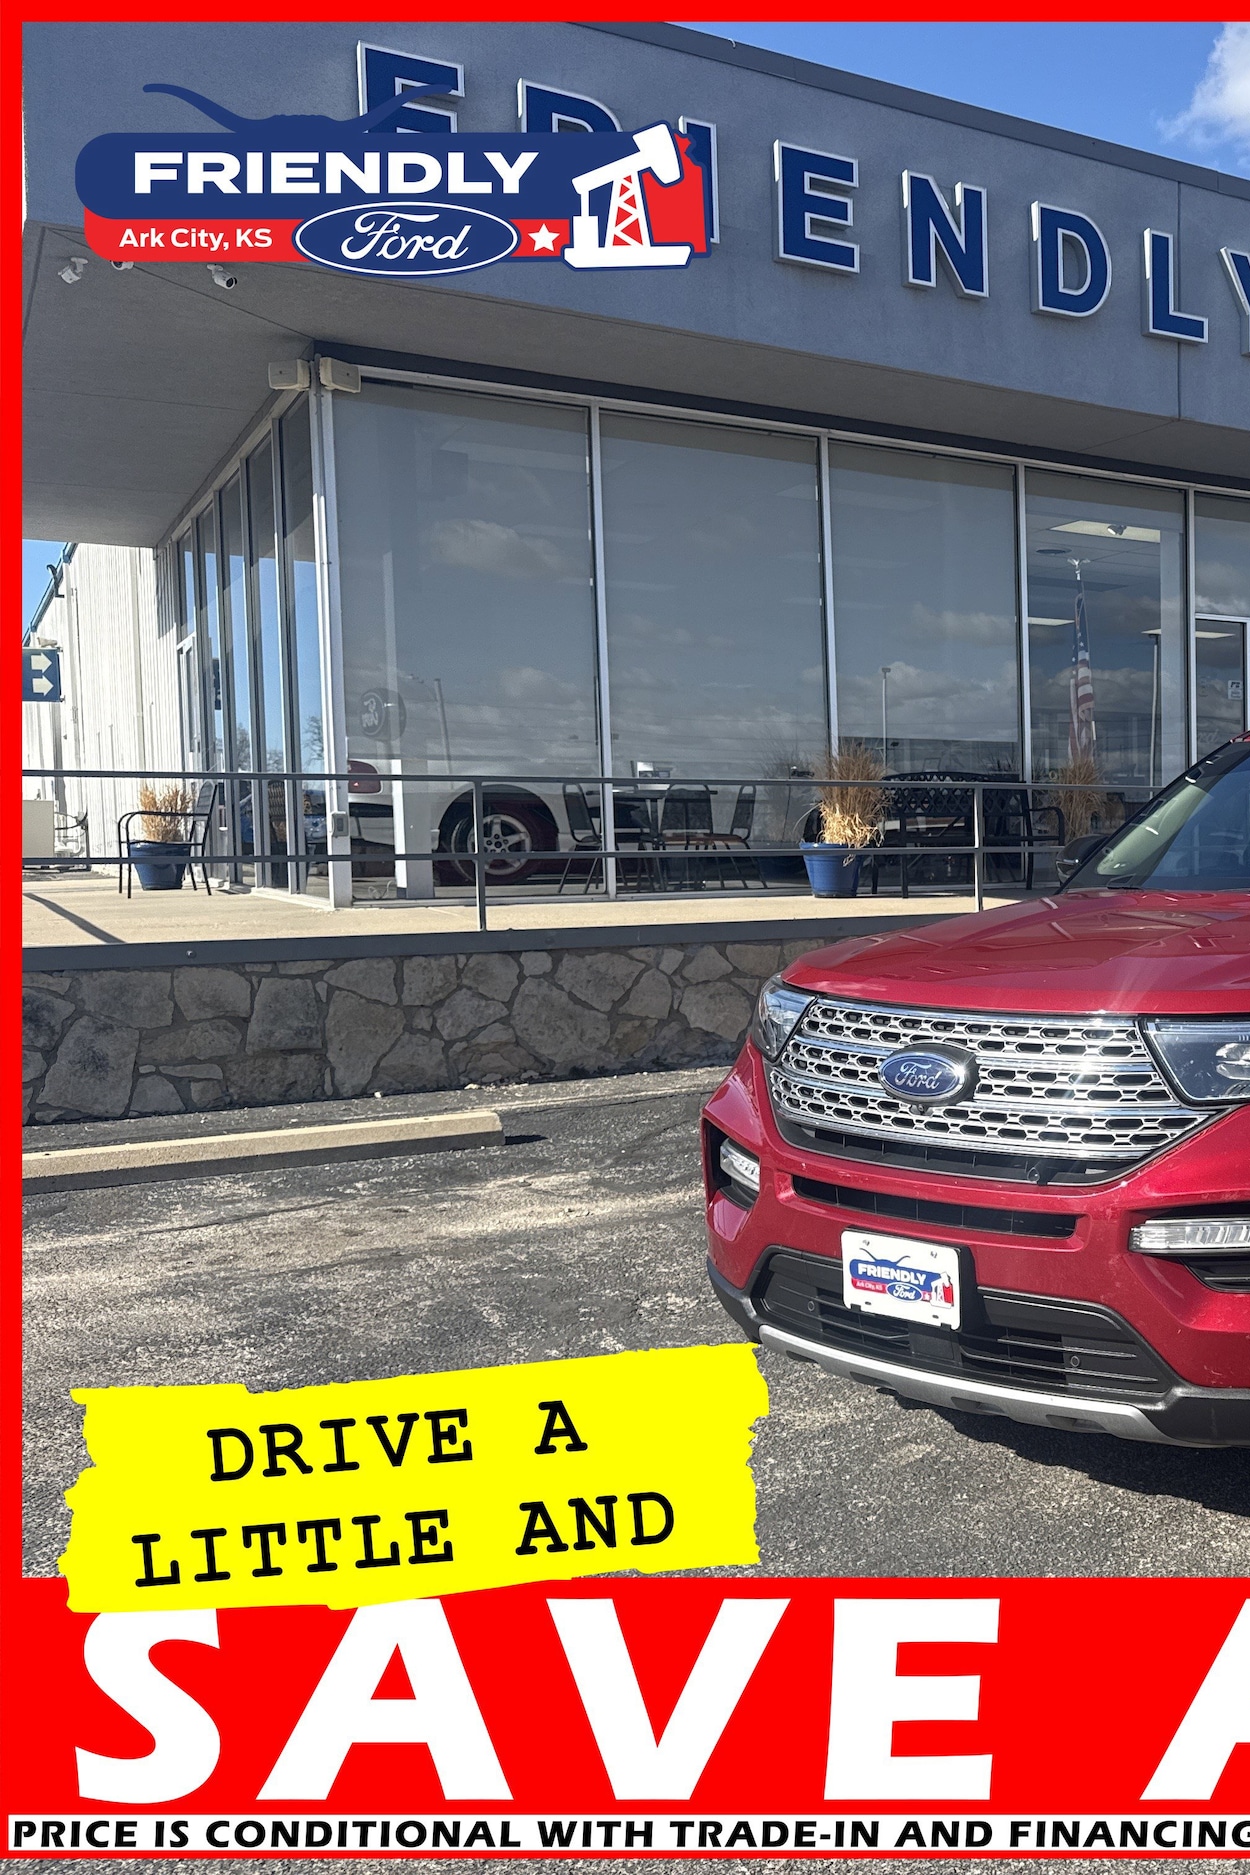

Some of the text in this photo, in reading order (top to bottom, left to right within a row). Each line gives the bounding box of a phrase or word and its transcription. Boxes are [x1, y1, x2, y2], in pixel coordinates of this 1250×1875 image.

[894, 1061, 943, 1090] Ford
[857, 1262, 926, 1286] FRIENDLY
[892, 1284, 916, 1300] Ford
